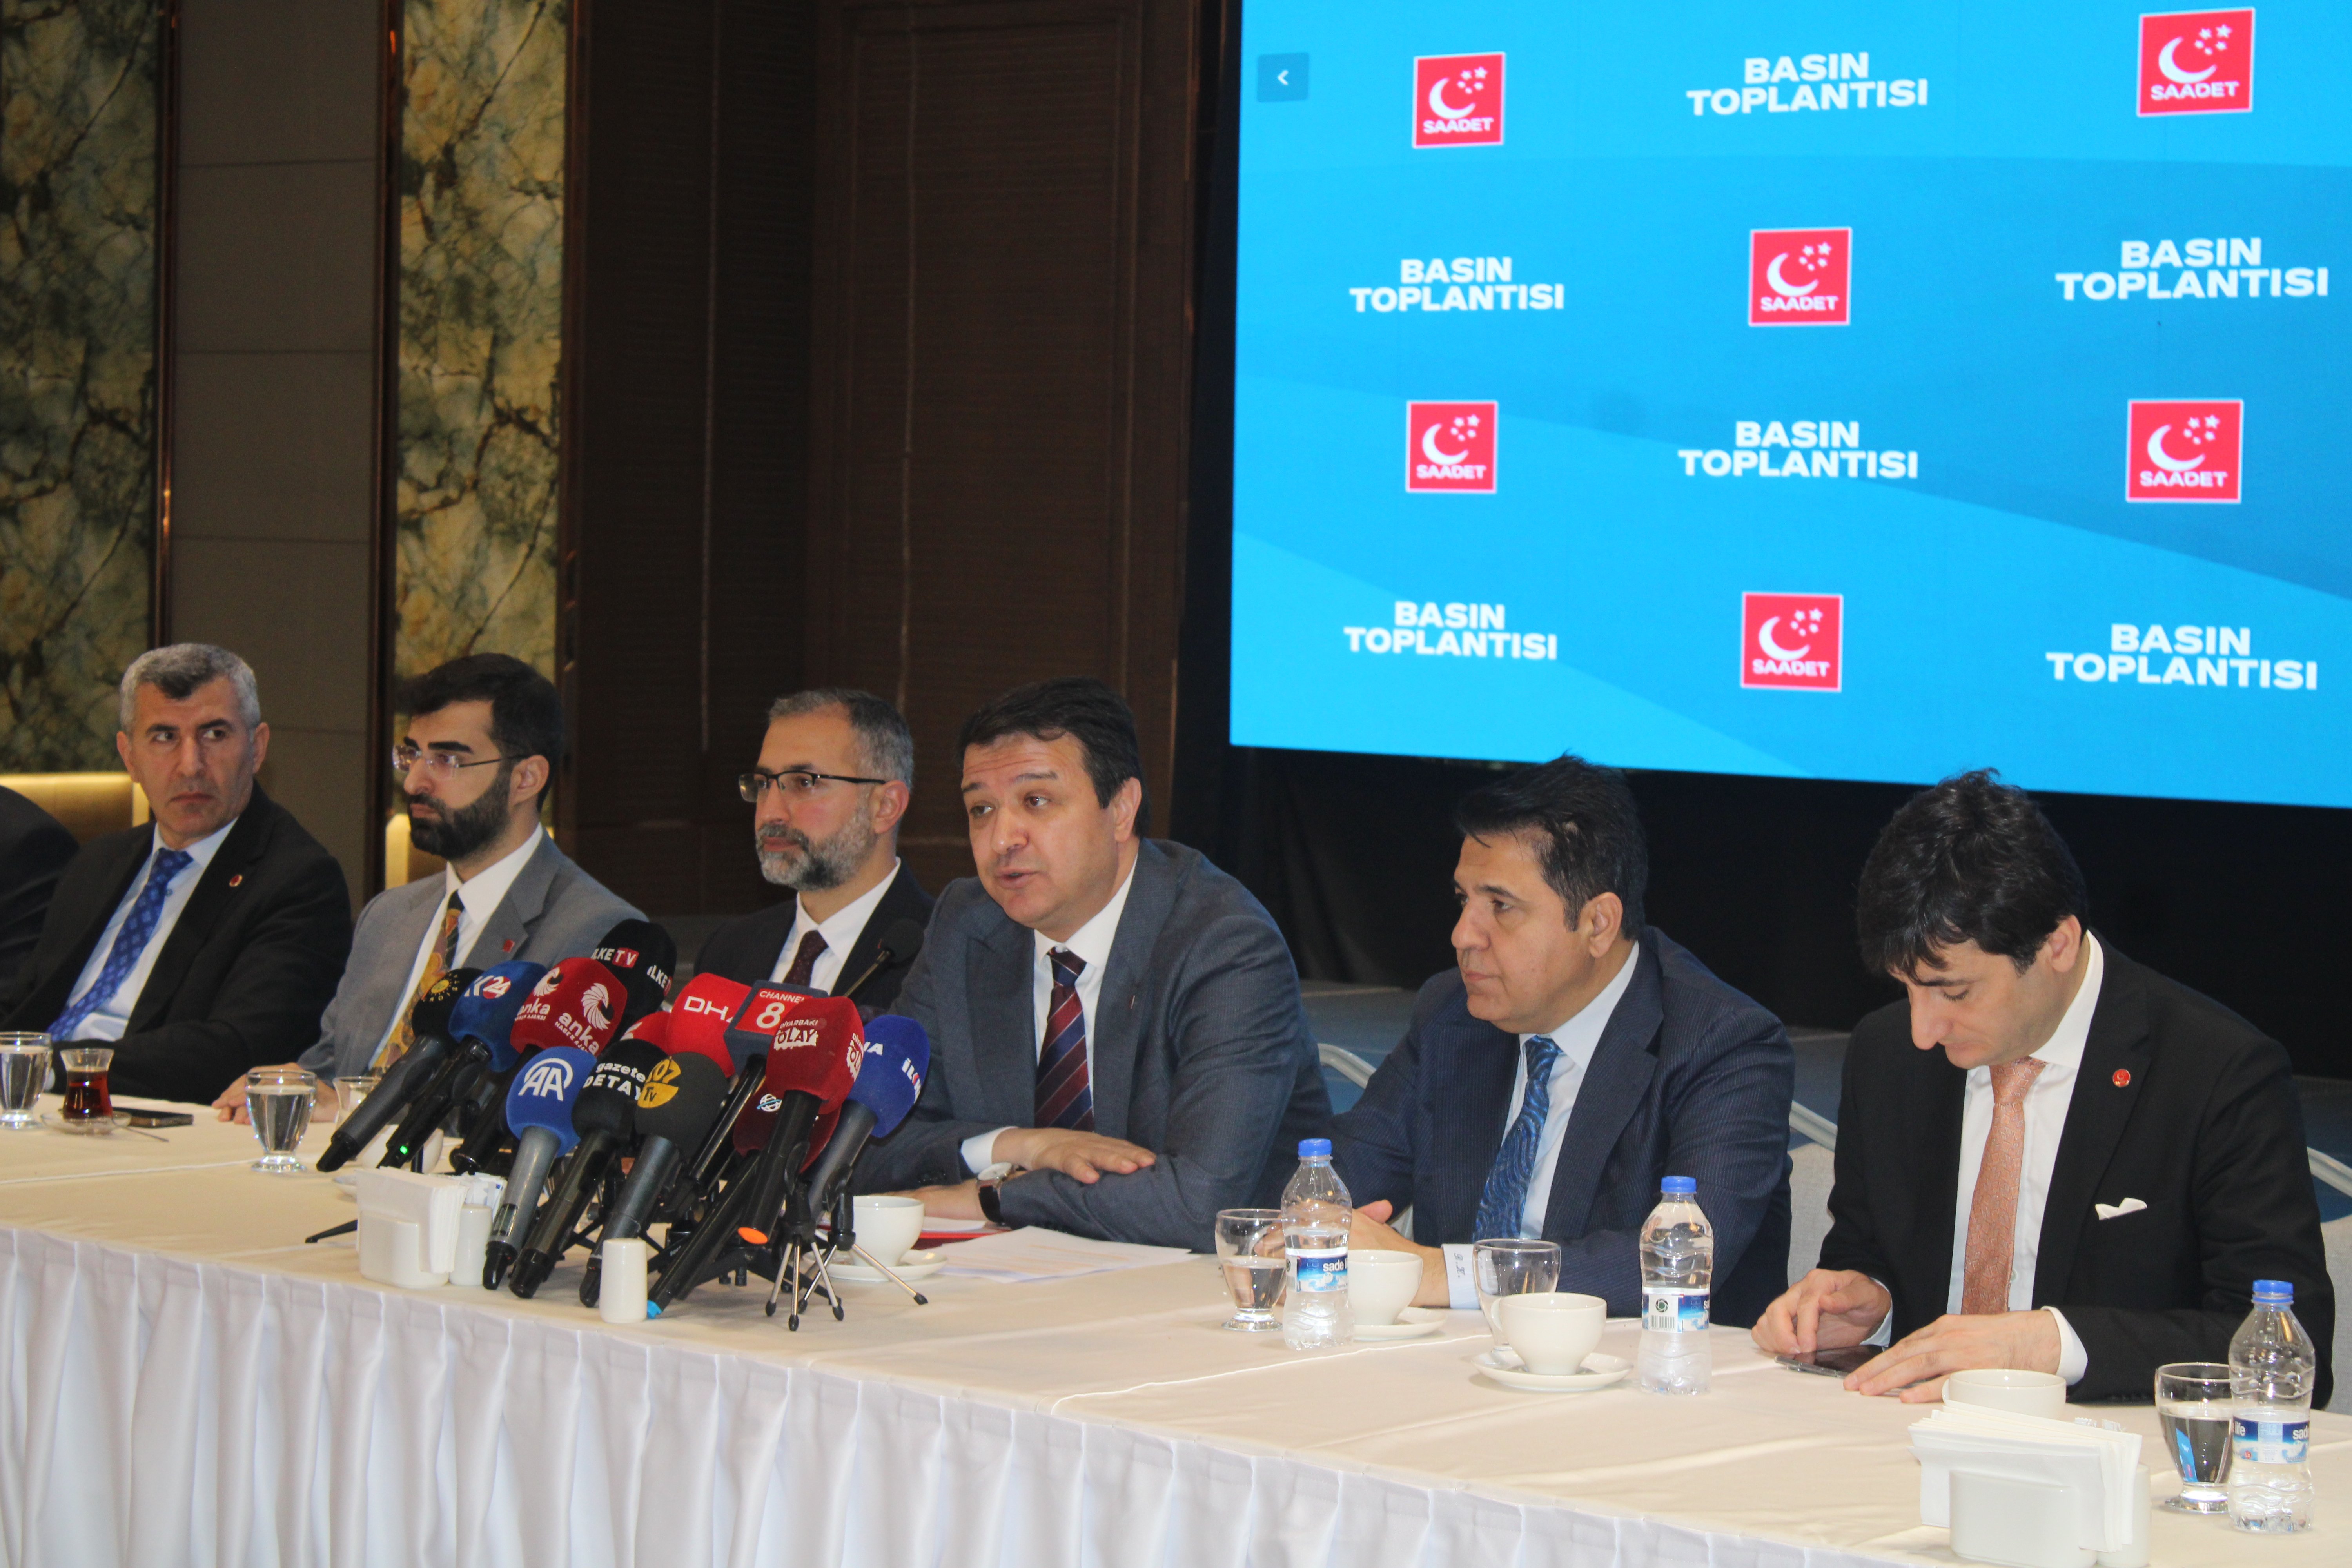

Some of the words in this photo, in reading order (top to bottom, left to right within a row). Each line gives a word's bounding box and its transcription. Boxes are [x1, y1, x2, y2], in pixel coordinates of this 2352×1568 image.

[1744, 52, 1869, 84] BASIN
[1686, 78, 1928, 116] TOPLANTISI
[2151, 80, 2239, 100] SAADET
[1423, 117, 1494, 134] SAADET
[2122, 238, 2261, 269] BASIN
[1401, 257, 1512, 284] BASIN
[2055, 268, 2328, 300] TOPLANTISI
[1349, 283, 1564, 312] TOPLANTISI
[1760, 296, 1839, 312] SAADET
[1736, 421, 1859, 448] BASIN
[1416, 464, 1487, 480] SAADET
[1678, 450, 1918, 478] TOPLANTISI
[2140, 470, 2228, 487] SAADET
[1394, 601, 1505, 630] BASIN
[1343, 627, 1557, 660] TOPLANTISI
[2111, 624, 2250, 656] BASIN
[1752, 659, 1830, 677] SAADET
[2046, 652, 2317, 690] TOPLANTISI
[615, 949, 636, 965] TV
[683, 996, 733, 1023] DH
[756, 1002, 785, 1029] 8
[559, 1013, 599, 1055] anka
[777, 1027, 817, 1044] OLAY
[517, 1066, 564, 1102] AA
[595, 1063, 646, 1083] gazete
[1323, 1259, 1344, 1272] sade
